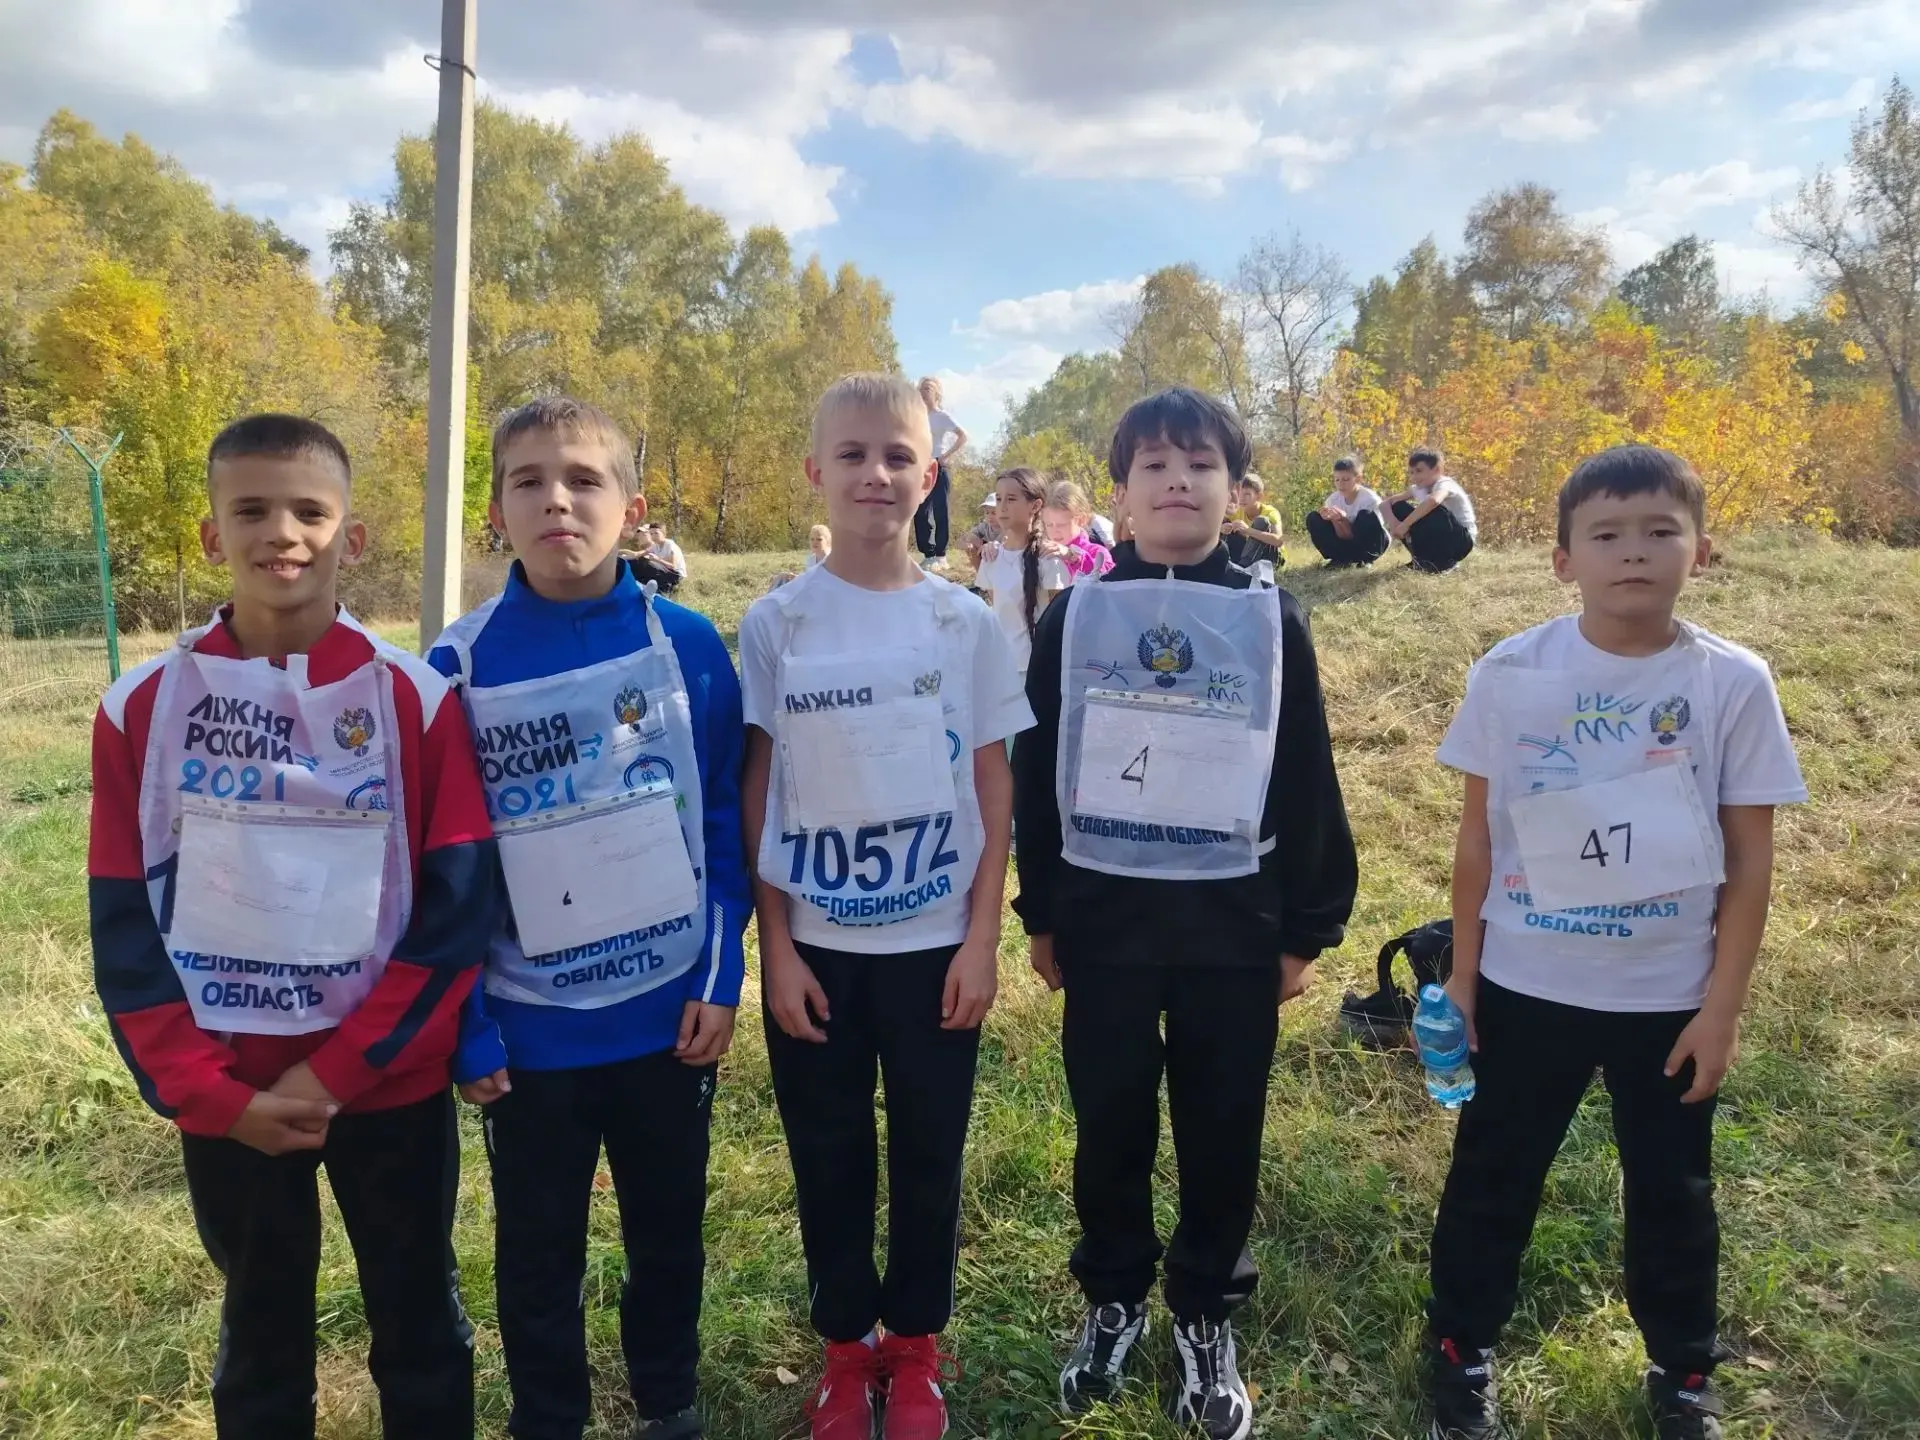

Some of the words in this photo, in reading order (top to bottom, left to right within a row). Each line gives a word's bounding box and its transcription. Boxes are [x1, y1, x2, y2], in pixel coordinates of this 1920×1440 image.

[477, 712, 571, 753] ЫЖНЯ
[177, 758, 285, 802] 2021
[479, 739, 578, 783] ОССИИ
[1580, 822, 1631, 868] 47
[1524, 913, 1633, 938] ОБЛАСТЬ
[552, 948, 664, 988] ОБЛАСТЬ
[201, 981, 324, 1011] ОБЛАСТЬ
